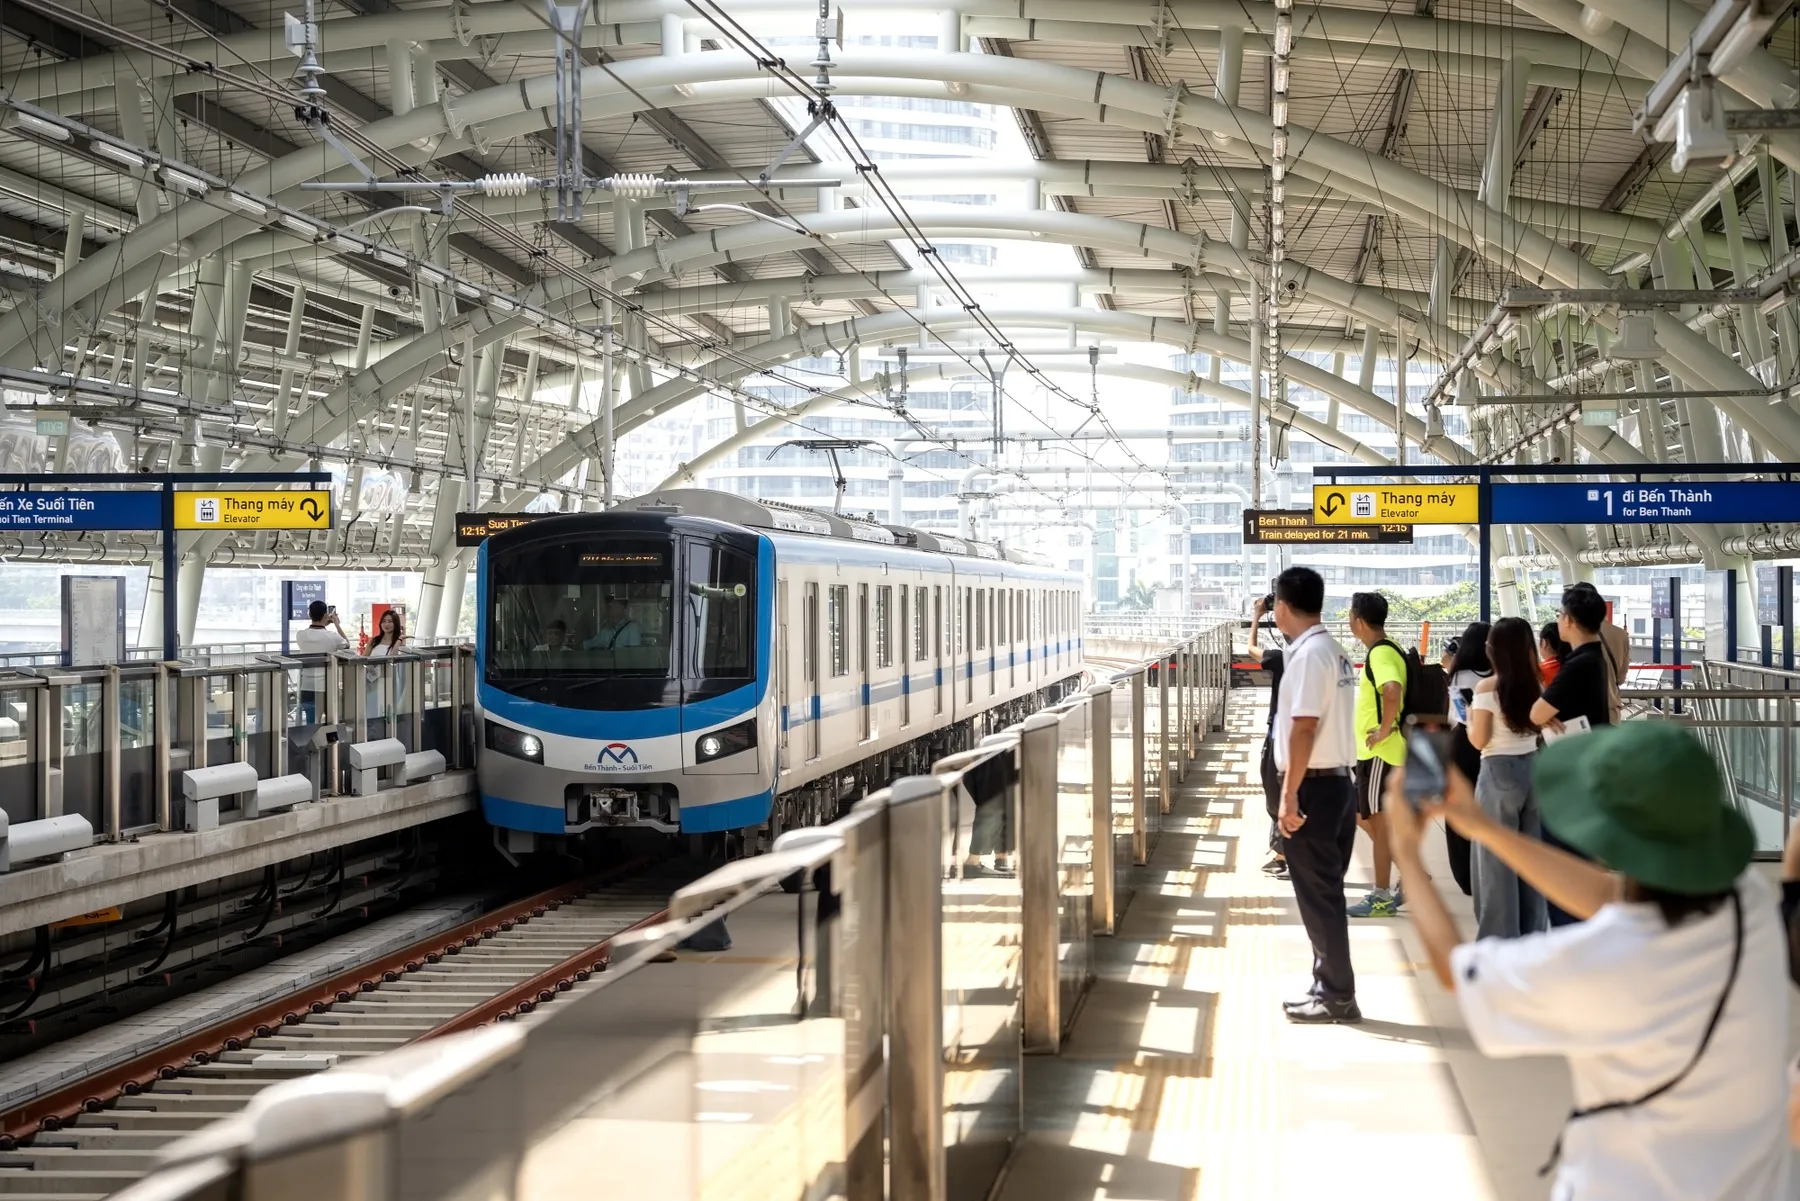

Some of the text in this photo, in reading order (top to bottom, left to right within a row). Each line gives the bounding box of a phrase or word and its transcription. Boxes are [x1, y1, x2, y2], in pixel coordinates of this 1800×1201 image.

[1381, 491, 1456, 507] Thang máy
[1622, 488, 1713, 502] đi Bến Thành
[17, 498, 33, 510] Xe
[36, 496, 65, 510] Suối
[67, 498, 95, 510] Tiên
[224, 497, 295, 513] Thang máy
[1604, 490, 1613, 516] 1
[1381, 509, 1420, 518] Elevator
[1622, 506, 1692, 516] for Ben Thanh
[11, 514, 31, 524] Tien
[33, 514, 74, 524] Terminal
[223, 514, 260, 523] Elevator
[1259, 516, 1308, 526] Ben Thanh
[488, 519, 509, 529] Suoi
[1248, 519, 1255, 535] 1
[1381, 524, 1408, 532] 12:15
[461, 526, 486, 536] 12:15
[1259, 530, 1370, 541] Train delayed for 21 min.
[584, 763, 597, 771] Bến
[598, 764, 618, 772] Thành
[622, 763, 638, 772] Suối
[638, 763, 653, 771] Tiên
